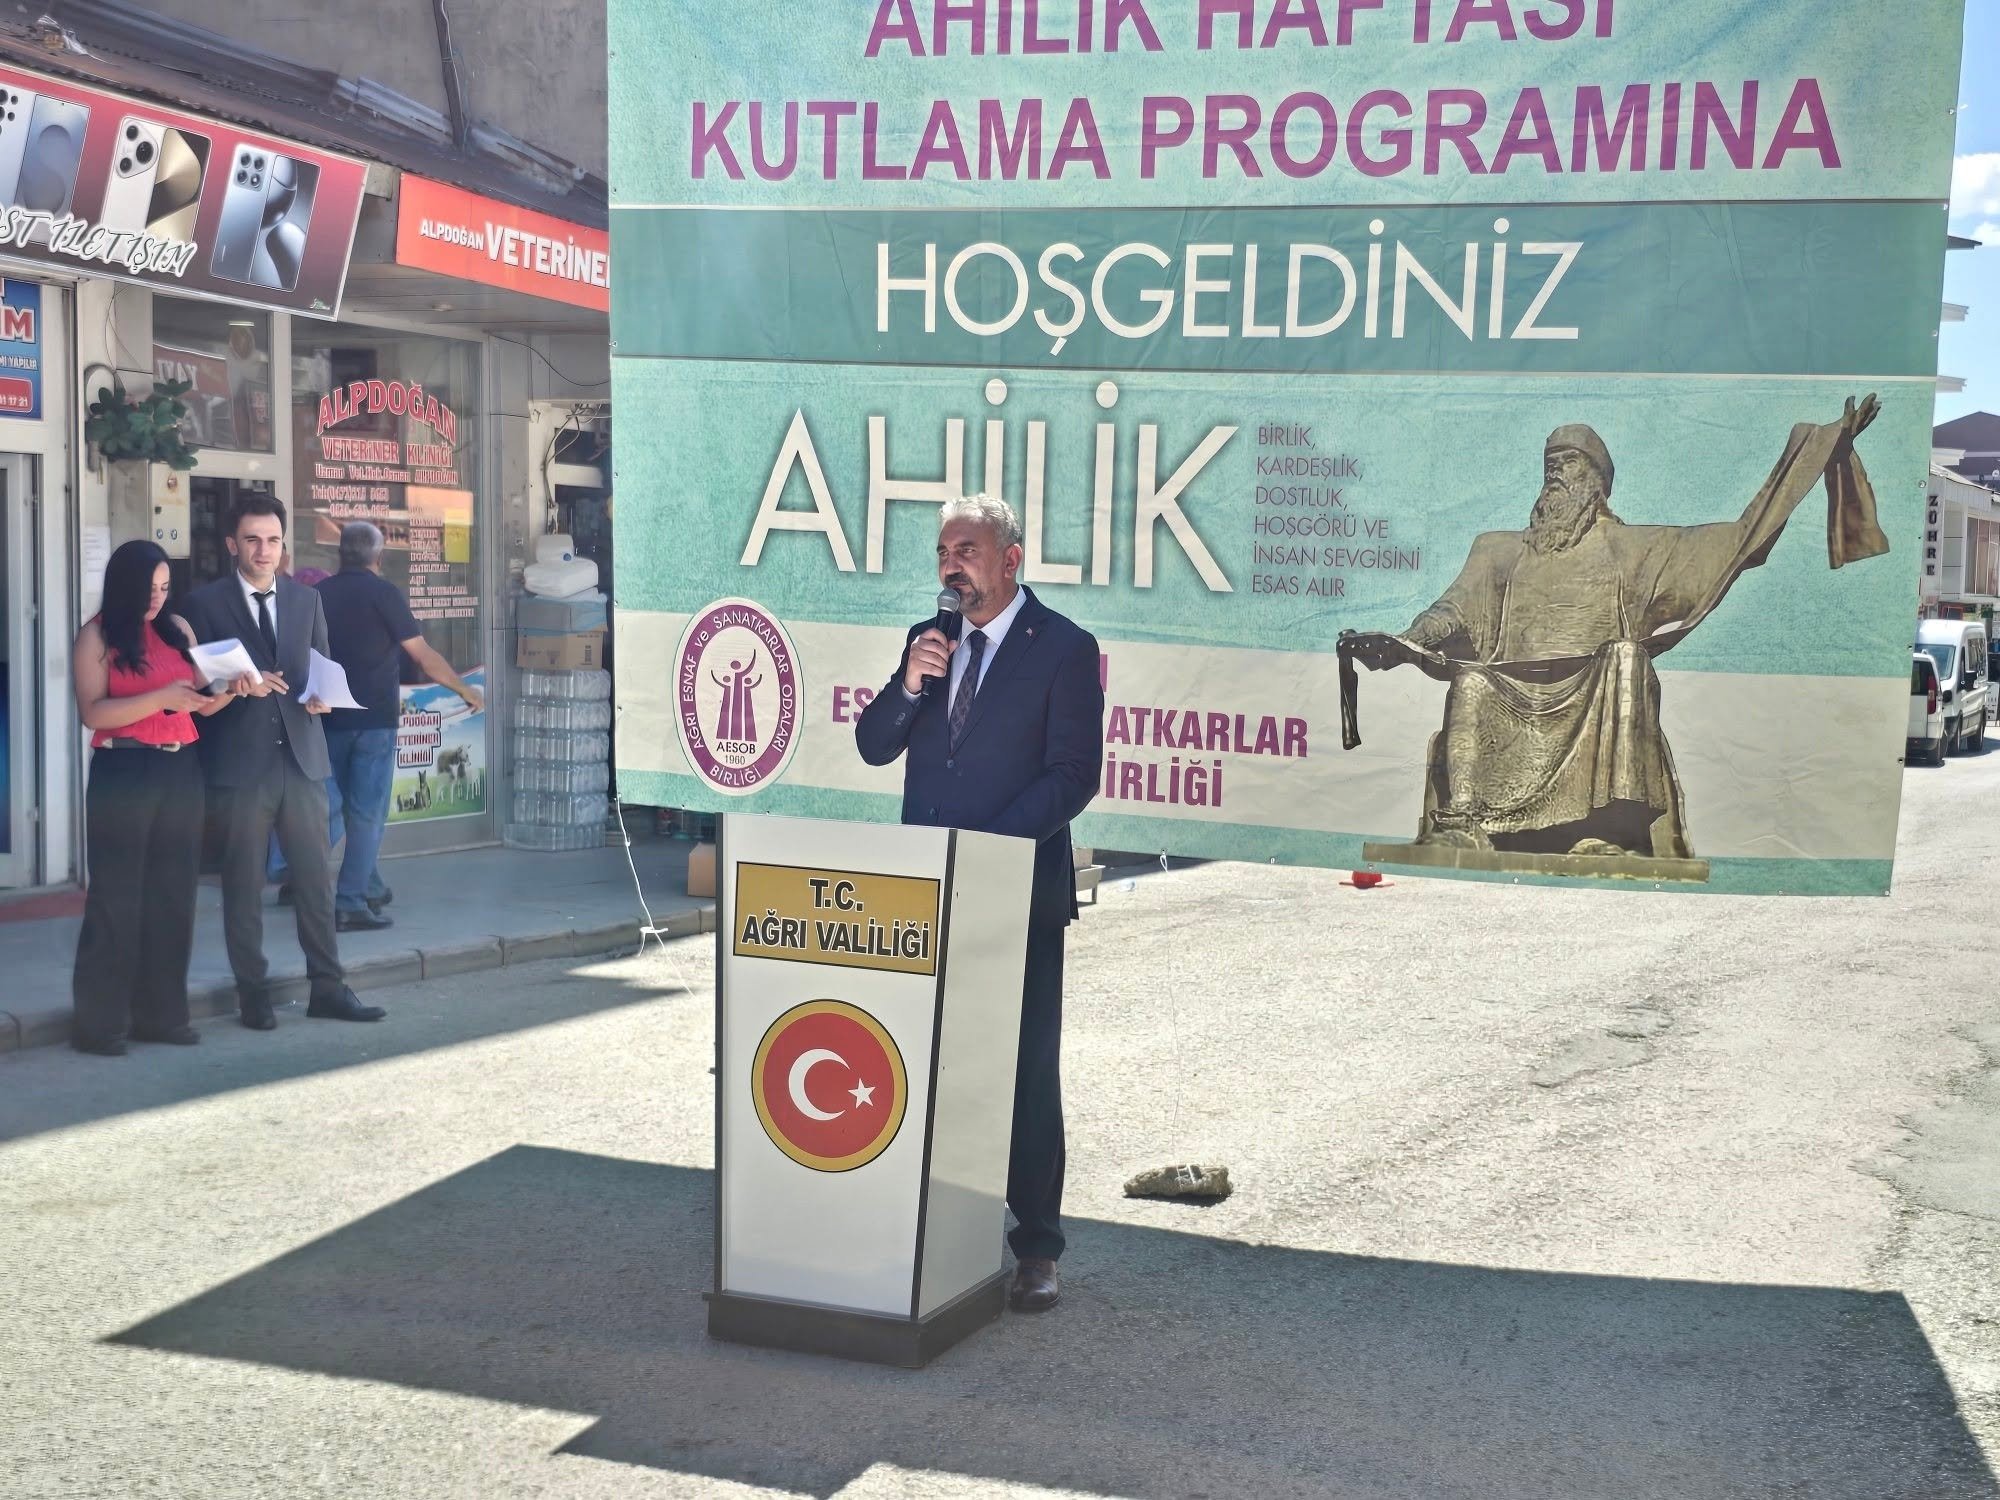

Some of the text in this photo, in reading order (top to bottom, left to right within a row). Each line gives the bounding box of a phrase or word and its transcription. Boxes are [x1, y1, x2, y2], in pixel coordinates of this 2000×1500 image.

[691, 78, 1842, 181] KUTLAMA PROGRAMINA
[0, 206, 54, 247] ST
[419, 218, 485, 251] ALPDOĞAN
[876, 218, 1585, 356] HOŞGELDİNİZ
[316, 380, 457, 447] ALPDOĞAN
[1258, 423, 1316, 450] BİRLİK,
[739, 378, 1240, 593] AHİLİK
[1256, 454, 1364, 482] KARDEŞLİK,
[1255, 486, 1348, 511] DOSTLUK,
[1254, 513, 1389, 539] HOŞGÖRÜ VE
[1253, 541, 1420, 570] İNSAN SEVGİSİNİ
[1252, 575, 1345, 597] ESAS ALIR
[683, 610, 793, 786] AĞRI ESNAF ve SANATKARLAR ODALARI BİRLİĞİ
[716, 741, 756, 755] AESOB
[1105, 705, 1308, 758] ATKARLAR
[724, 754, 746, 766] 1960
[1105, 751, 1223, 808] İRLİĞİ
[808, 877, 865, 912] T.C.
[741, 908, 930, 960] AĞRI VALİLİĞİ
